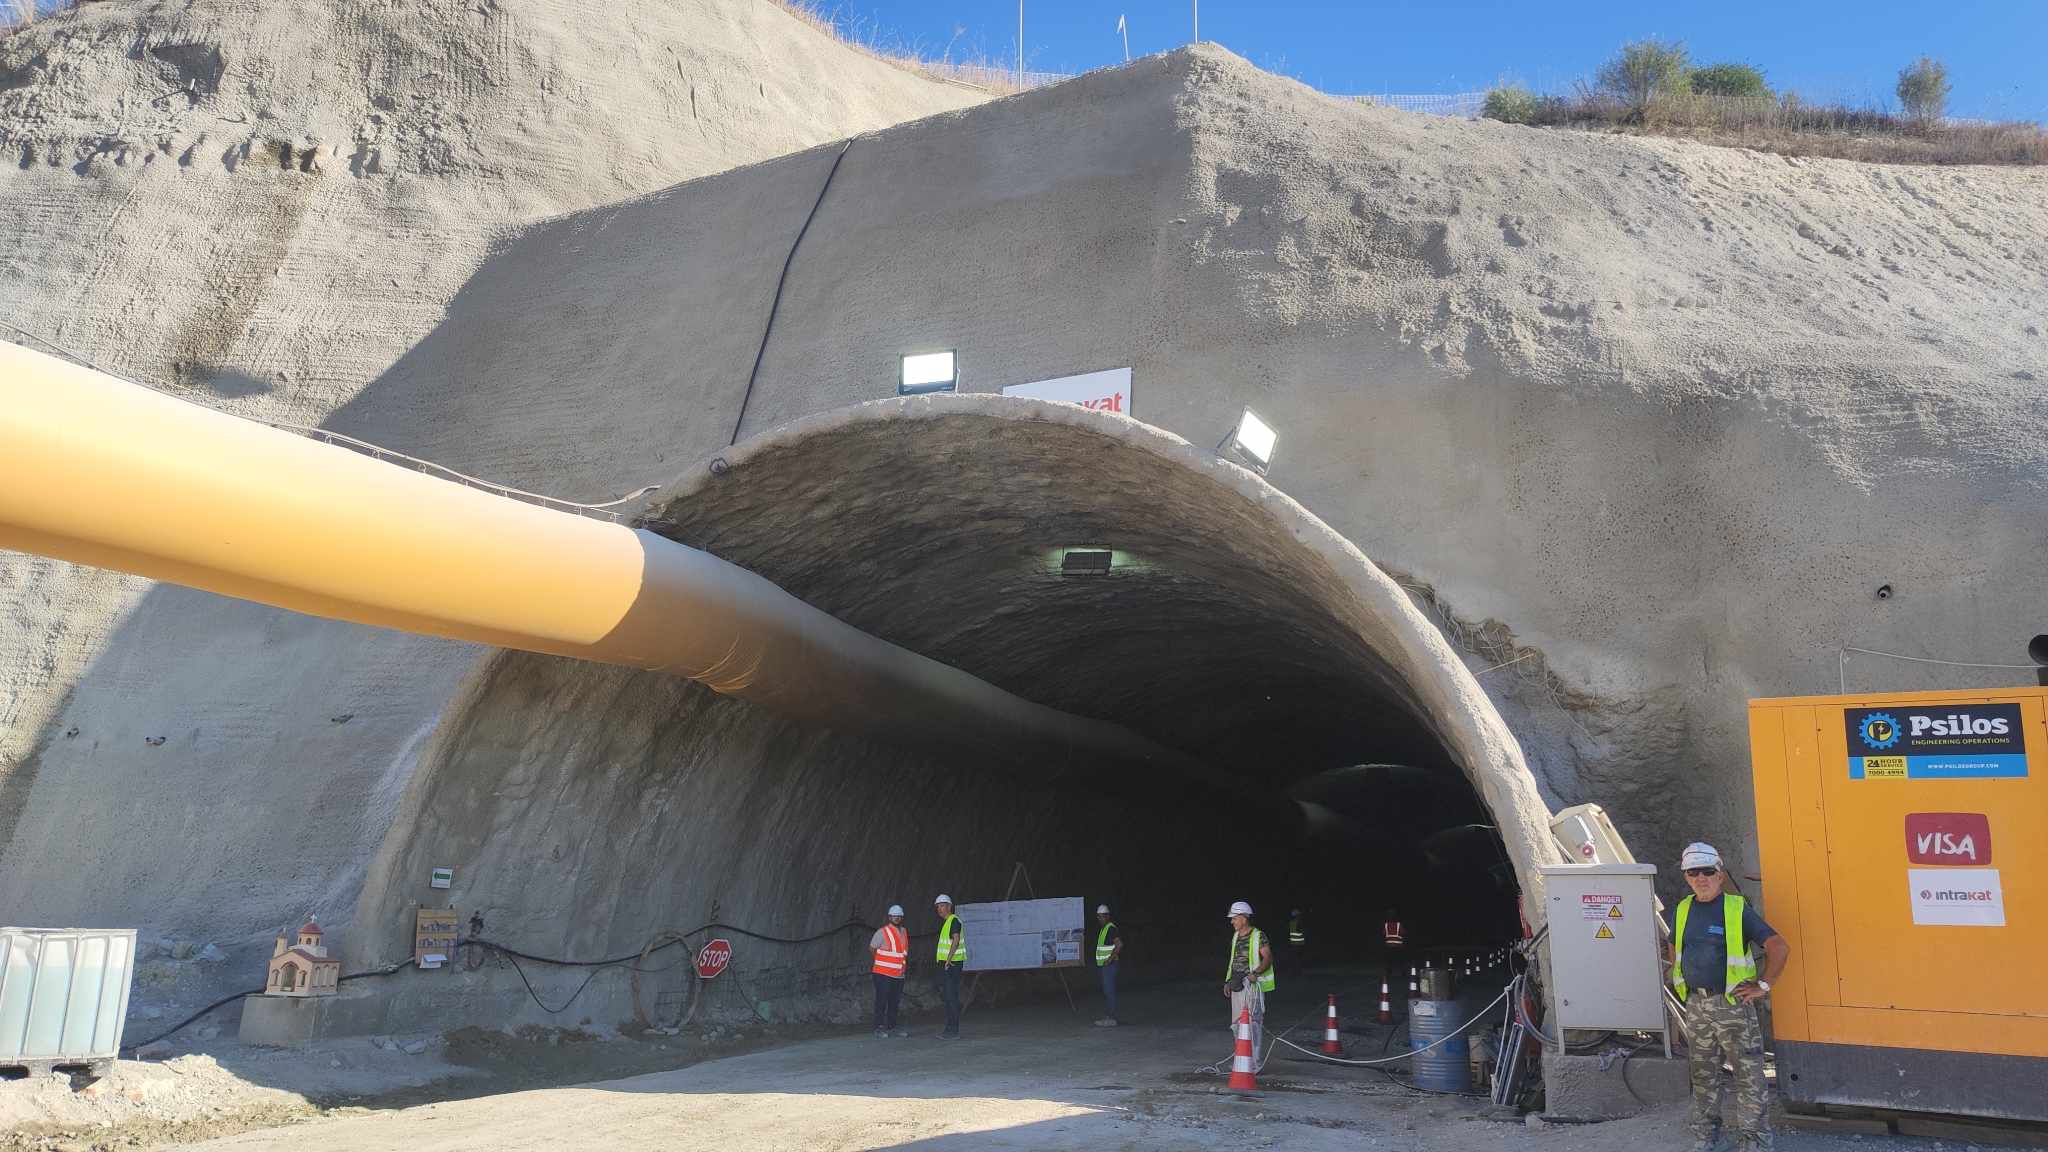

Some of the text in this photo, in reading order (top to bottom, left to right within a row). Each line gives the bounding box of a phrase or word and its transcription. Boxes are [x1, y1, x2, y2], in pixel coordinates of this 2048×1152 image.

[1080, 392, 1122, 411] kat
[1909, 714, 2009, 736] Psilos
[1962, 737, 2010, 745] OPERATIONS
[1867, 759, 1880, 768] 24
[1917, 832, 1976, 860] VISA
[1935, 889, 1992, 901] intrakat
[699, 950, 729, 967] STOP
